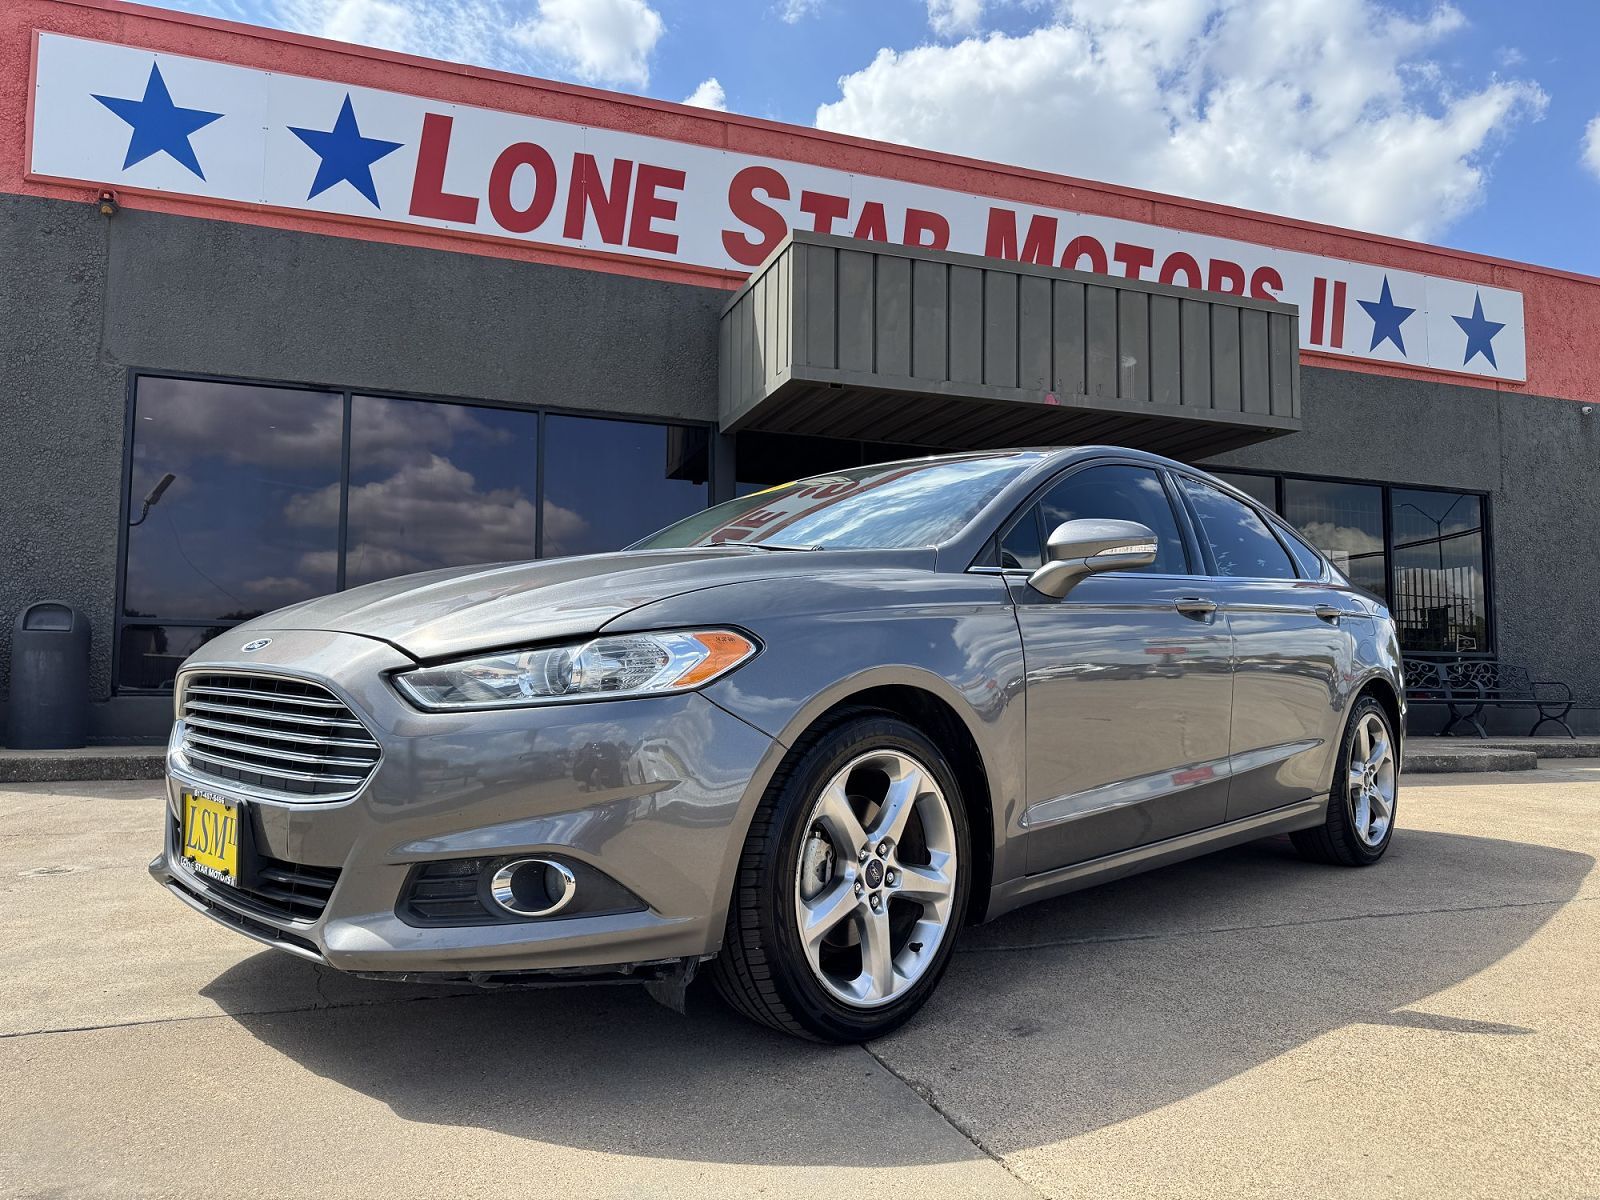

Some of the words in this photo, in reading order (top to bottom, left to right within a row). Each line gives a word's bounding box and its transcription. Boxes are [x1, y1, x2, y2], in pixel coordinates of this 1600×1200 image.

[408, 112, 687, 255] LONE
[1310, 276, 1347, 348] II
[186, 805, 231, 860] LSM
